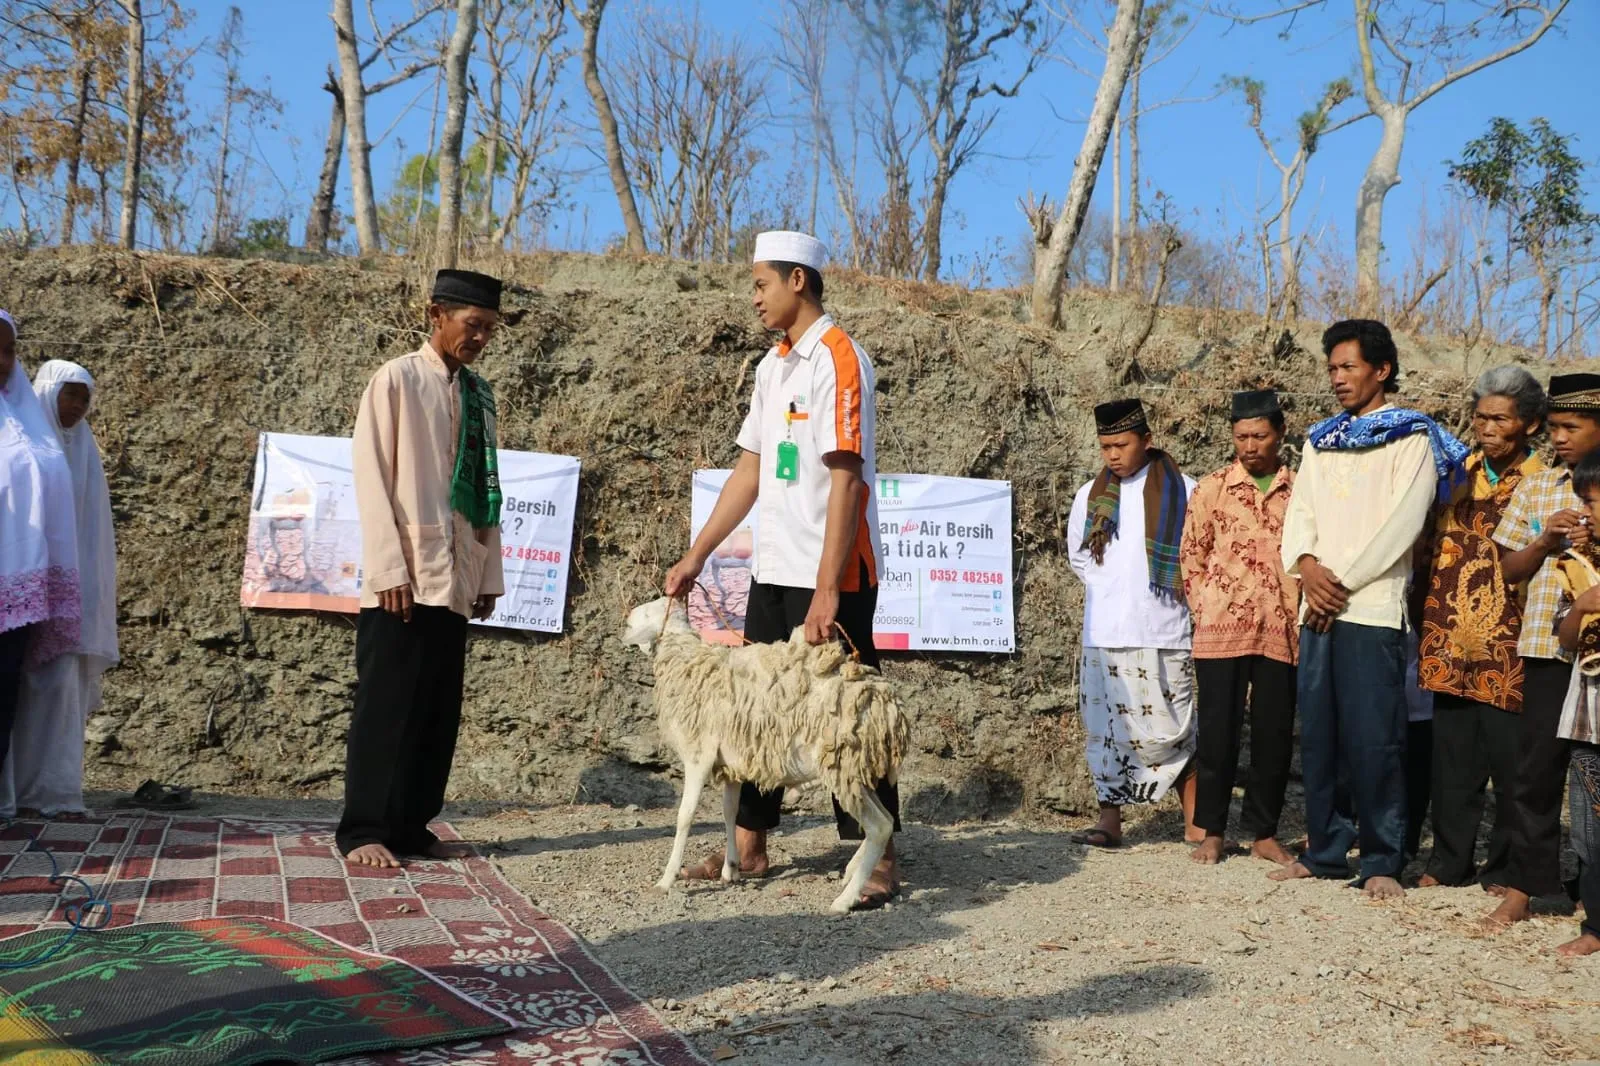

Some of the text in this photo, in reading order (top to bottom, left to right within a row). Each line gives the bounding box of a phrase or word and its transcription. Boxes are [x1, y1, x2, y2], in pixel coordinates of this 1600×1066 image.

[506, 496, 556, 517] Bersih
[900, 519, 919, 535] plus
[919, 520, 941, 536] Air
[946, 522, 993, 539] Bersih
[517, 547, 561, 563] 482548
[898, 540, 948, 558] tidak
[930, 569, 1004, 585] 0352 482548
[921, 635, 1009, 647] www.bmh.or.id
